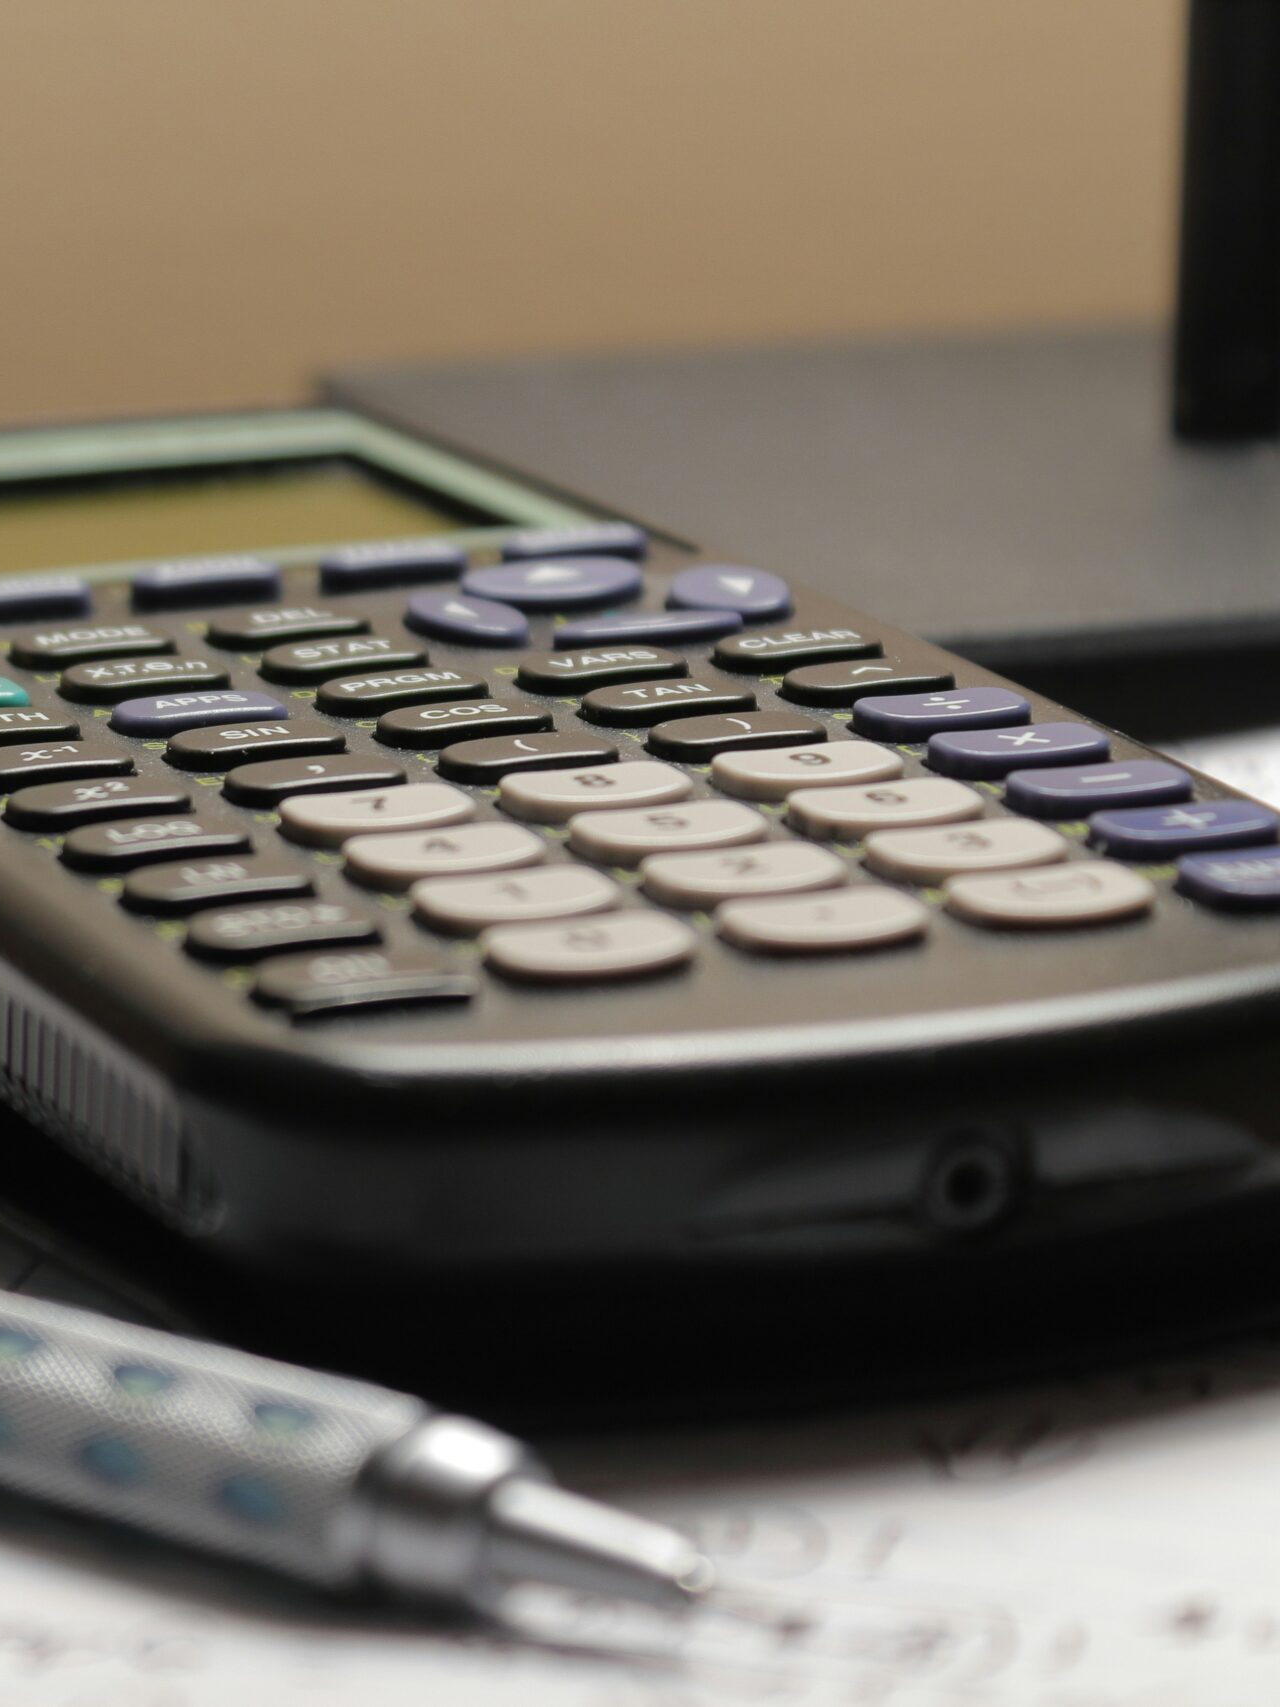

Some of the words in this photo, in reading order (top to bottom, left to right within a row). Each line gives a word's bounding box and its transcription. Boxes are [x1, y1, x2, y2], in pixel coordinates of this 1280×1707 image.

[251, 607, 332, 625] DEL
[34, 626, 152, 647] MODE
[738, 628, 862, 650] CLEAR
[293, 639, 391, 660] STAT
[548, 650, 659, 669] VARS
[340, 671, 463, 693] PRGM
[621, 682, 713, 699] TAN
[155, 693, 249, 710] APPS
[419, 703, 510, 721] COS
[219, 725, 291, 741] SIN
[788, 751, 832, 766] 9
[573, 773, 616, 789] 8
[350, 795, 388, 811] 7
